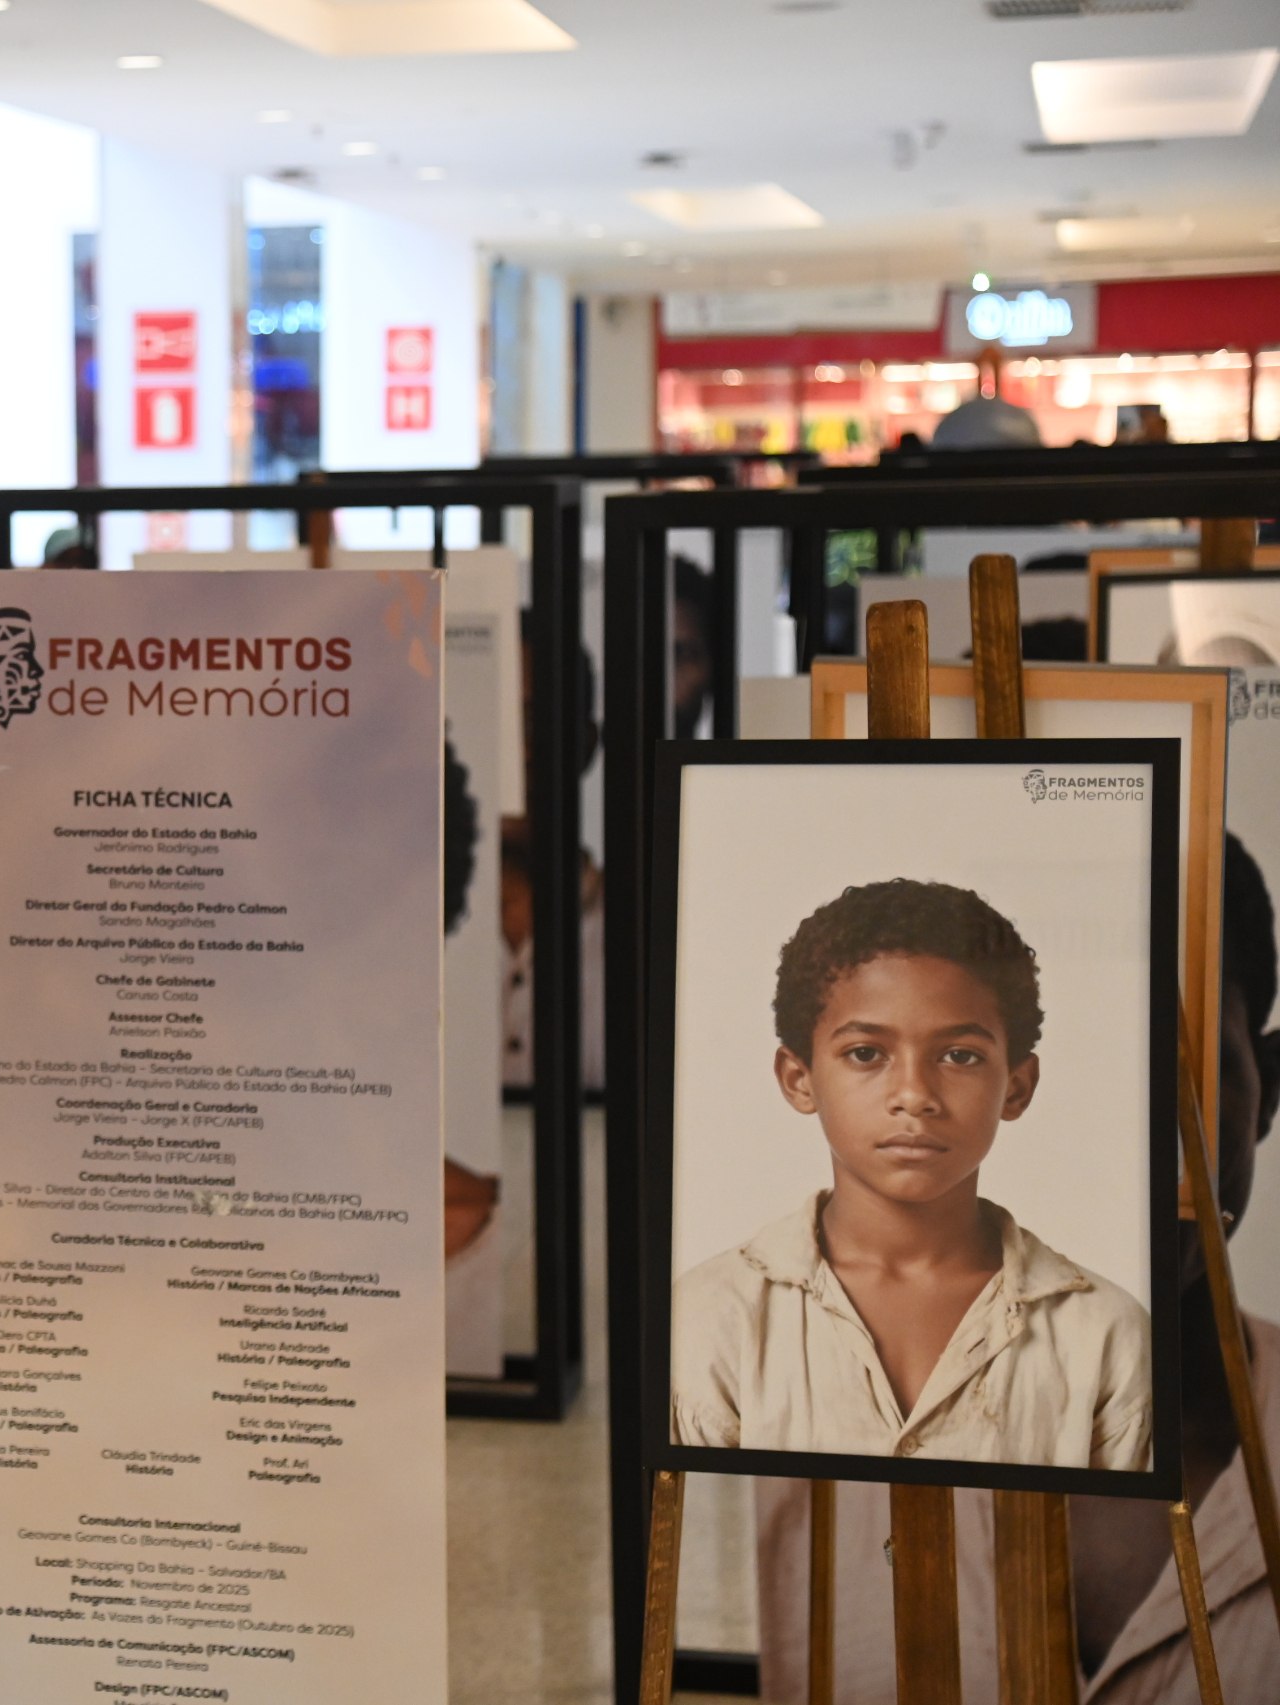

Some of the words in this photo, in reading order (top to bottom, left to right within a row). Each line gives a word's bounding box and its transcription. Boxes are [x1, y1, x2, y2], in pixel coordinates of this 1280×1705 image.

[49, 637, 351, 671] FRAGMENTOS
[48, 680, 108, 716] de
[128, 679, 350, 717] Memória
[1049, 778, 1144, 787] FRAGMENTOS
[74, 791, 136, 807] FICHA
[141, 787, 232, 808] TÉCNICA
[1049, 790, 1068, 800] de
[1074, 789, 1144, 801] Memória
[53, 827, 129, 838] Governador
[132, 828, 148, 838] do
[152, 828, 196, 839] Estado
[199, 829, 216, 839] da
[220, 829, 257, 839] Bahia
[94, 842, 153, 853] Jerônimo
[157, 843, 219, 856] Rodrigues
[87, 864, 153, 875] Secretário
[156, 865, 173, 875] de
[176, 865, 224, 876] Cultura
[109, 878, 146, 890] Bruno
[148, 879, 205, 890] Monteiro
[25, 899, 70, 910] Diretor
[73, 900, 107, 911] Geral
[130, 901, 194, 915] Fundação
[197, 902, 235, 913] Pedro
[237, 903, 287, 914] Calmon
[146, 917, 216, 930] Magalhães
[10, 936, 54, 947] Diretor
[76, 937, 125, 950] Arquivo
[128, 938, 175, 949] Público
[198, 940, 243, 950] Estado
[266, 941, 304, 952] Bahia
[120, 953, 156, 966] Jorge
[159, 954, 194, 965] Vieira
[96, 974, 133, 985] Chefe
[136, 976, 152, 986] de
[156, 976, 215, 987] Gabinete
[109, 1012, 163, 1022] Assessor
[166, 1013, 203, 1024] Chefe
[120, 1048, 192, 1062] Realização
[35, 1060, 77, 1072] Estado
[100, 1062, 136, 1073] Bahia
[150, 1063, 213, 1076] Secretaria
[216, 1066, 232, 1076] de
[236, 1066, 282, 1078] Cultura
[29, 1074, 77, 1086] Calmon
[79, 1076, 112, 1088] (FPC)
[125, 1077, 172, 1090] Arquivo
[175, 1078, 220, 1090] Público
[243, 1080, 287, 1092] Estado
[310, 1082, 347, 1094] Bahia
[350, 1084, 392, 1097] (APEB)
[56, 1097, 142, 1112] Coordenação
[144, 1100, 179, 1111] Geral
[182, 1104, 190, 1112] e
[193, 1101, 258, 1113] Curadoria
[53, 1112, 90, 1126] Jorge
[93, 1113, 127, 1124] Vieira
[141, 1115, 178, 1128] Jorge
[181, 1116, 189, 1125] X
[192, 1116, 264, 1130] (FPC/APEB)
[93, 1135, 154, 1149] Produção
[157, 1137, 220, 1149] Executiva
[79, 1171, 152, 1184] Consultoria
[155, 1174, 235, 1186] Institucional
[51, 1233, 115, 1245] Curadoria
[117, 1235, 165, 1247] Técnica
[179, 1237, 264, 1251] Colaborativa
[13, 1273, 83, 1286] Paleografia
[191, 1266, 243, 1277] Geovane
[246, 1268, 287, 1279] Gomes
[167, 1279, 215, 1290] História
[227, 1281, 272, 1292] Marcas
[275, 1284, 291, 1293] de
[294, 1284, 339, 1297] Nações
[342, 1286, 400, 1298] Africanas
[13, 1309, 83, 1323] Paleografia
[219, 1318, 292, 1331] Inteligência
[294, 1320, 348, 1332] Artificial
[18, 1344, 88, 1358] Paleografia
[217, 1353, 265, 1364] História
[277, 1355, 350, 1369] Paleografia
[23, 1369, 82, 1382] Gonçalves
[212, 1391, 266, 1404] Pesquisa
[269, 1395, 356, 1407] Independente
[9, 1420, 78, 1434] Paleografia
[226, 1430, 268, 1444] Design
[281, 1434, 343, 1447] Animação
[126, 1464, 174, 1476] História
[249, 1470, 321, 1485] Paleografia
[78, 1514, 152, 1528] Consultoria
[155, 1519, 241, 1533] Internacional
[35, 1557, 72, 1568] Local:
[76, 1558, 134, 1574] Shopping
[158, 1563, 194, 1575] Bahia
[208, 1566, 286, 1580] Salvador/BA
[130, 1579, 194, 1592] Novembro
[197, 1584, 214, 1593] de
[217, 1583, 250, 1595] 2025
[70, 1592, 136, 1607] Programa:
[140, 1596, 191, 1611] Resgate
[194, 1600, 251, 1613] Ancestral
[6, 1606, 22, 1616] de
[25, 1607, 84, 1621] Ativação:
[108, 1612, 144, 1623] Vozes
[166, 1615, 235, 1629] Fragmento
[237, 1619, 295, 1633] (Outubro
[297, 1624, 314, 1634] de
[317, 1624, 354, 1638] 2025)
[29, 1634, 95, 1647] Assessoria
[98, 1638, 114, 1648] de
[116, 1639, 203, 1655] Comunicação
[206, 1644, 295, 1662] (FPC/ASCOM)
[95, 1681, 138, 1696] Design
[140, 1684, 228, 1702] (FPC/ASCOM)
